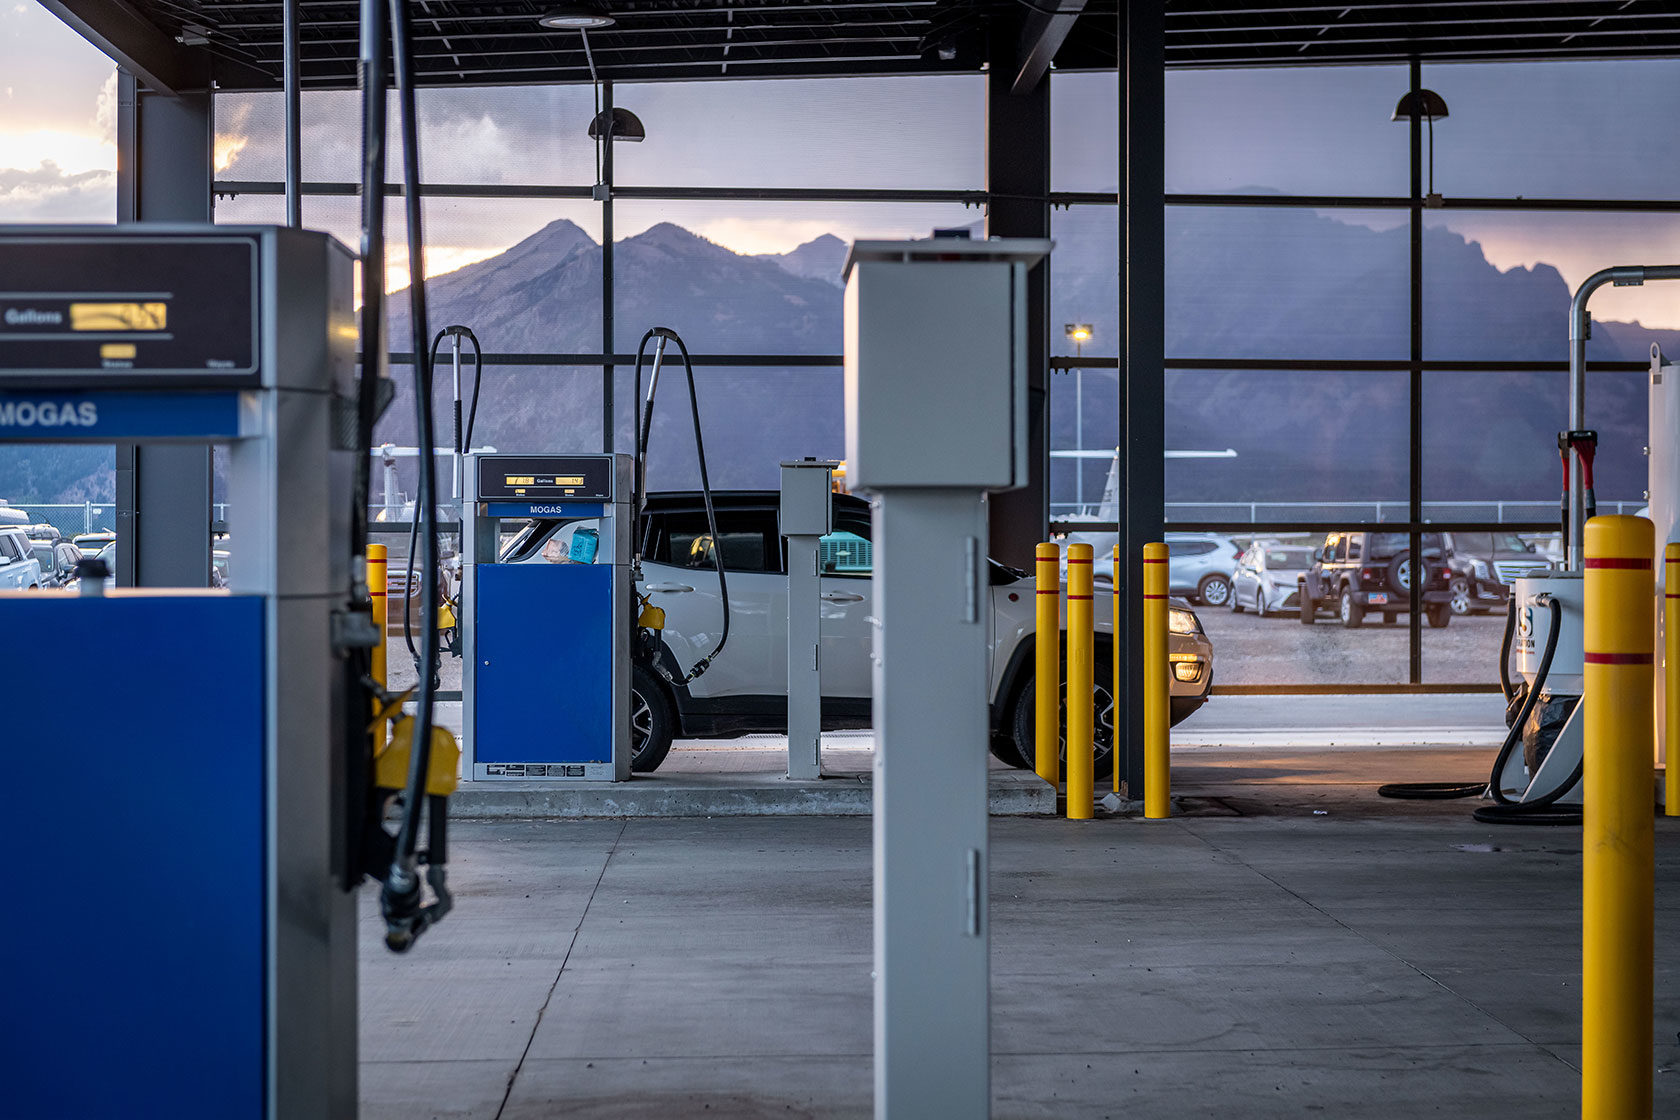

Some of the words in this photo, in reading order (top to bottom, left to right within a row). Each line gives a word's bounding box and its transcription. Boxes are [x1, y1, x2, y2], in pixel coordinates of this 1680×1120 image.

[5, 308, 62, 324] Gallons
[0, 402, 97, 425] MOGAS
[530, 505, 562, 514] MOGAS
